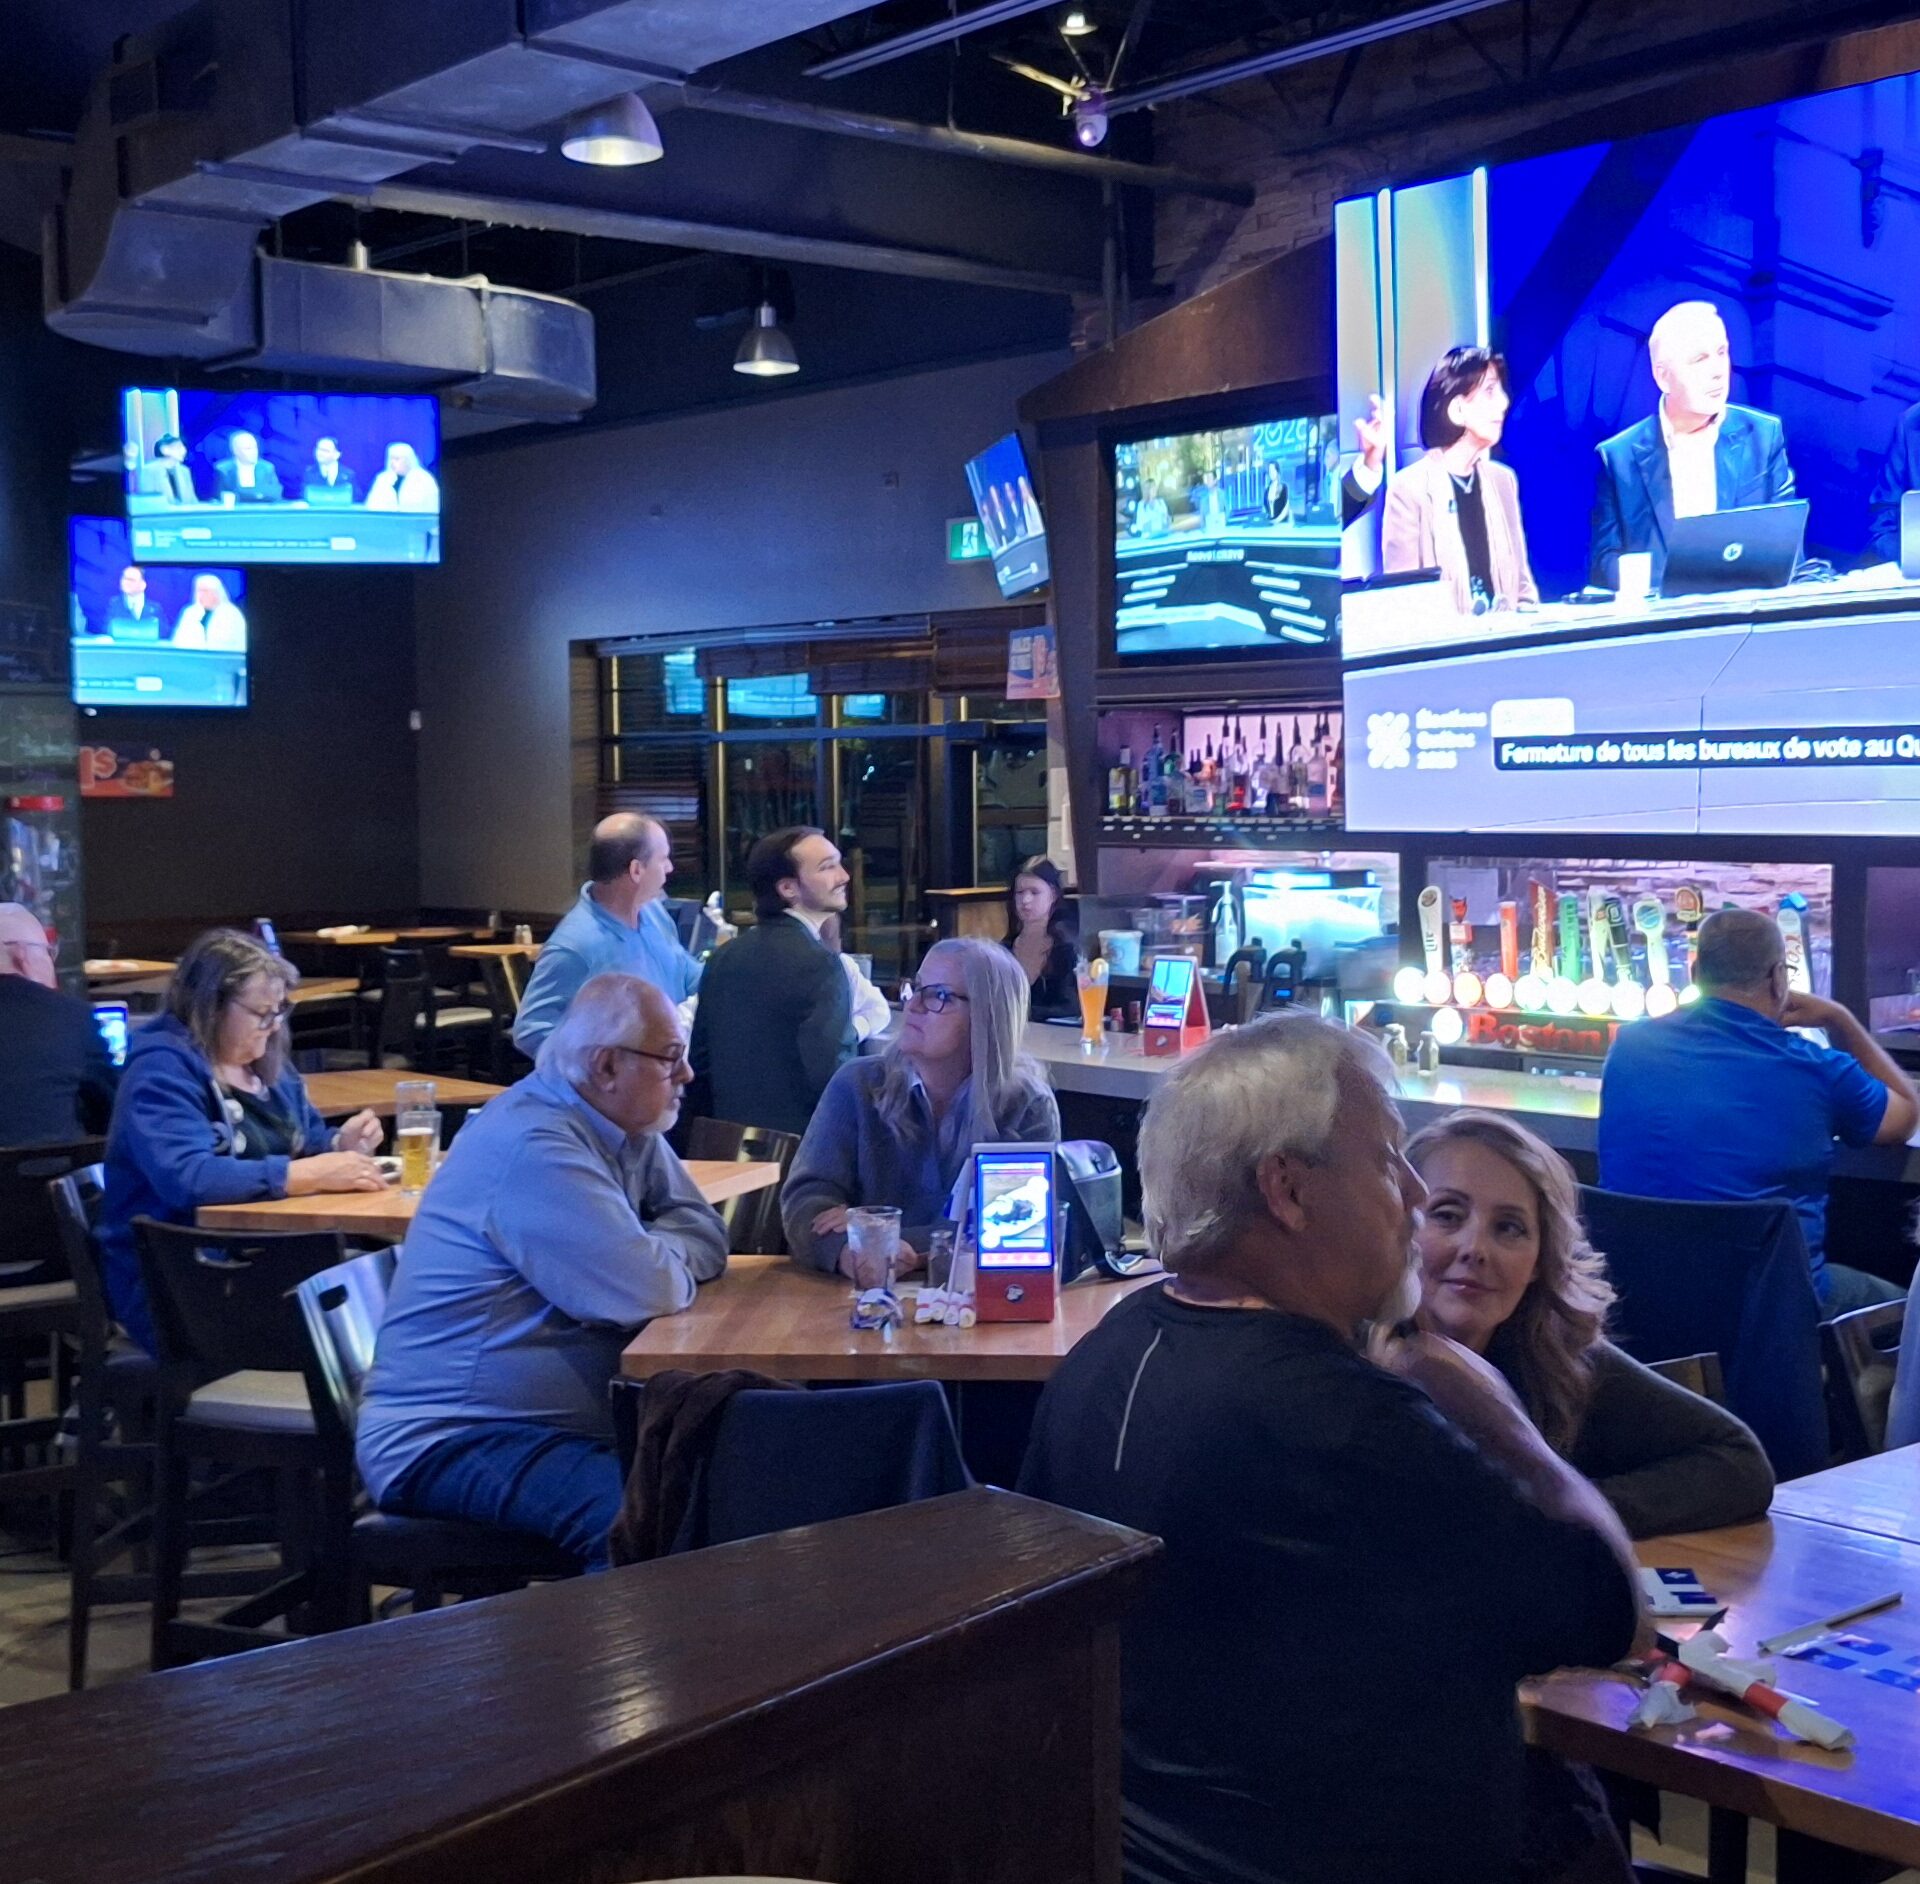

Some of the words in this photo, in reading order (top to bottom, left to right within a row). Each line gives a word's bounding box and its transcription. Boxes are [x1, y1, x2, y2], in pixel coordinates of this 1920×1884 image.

[1501, 743, 1593, 764] Fermeture
[1596, 740, 1620, 763] de
[1622, 742, 1665, 763] tous
[1667, 738, 1696, 762] les
[1699, 738, 1781, 761] bureaux
[1783, 736, 1810, 759] de
[1812, 737, 1862, 758] vote
[1865, 738, 1893, 758] au
[1468, 1013, 1602, 1052] Boston
